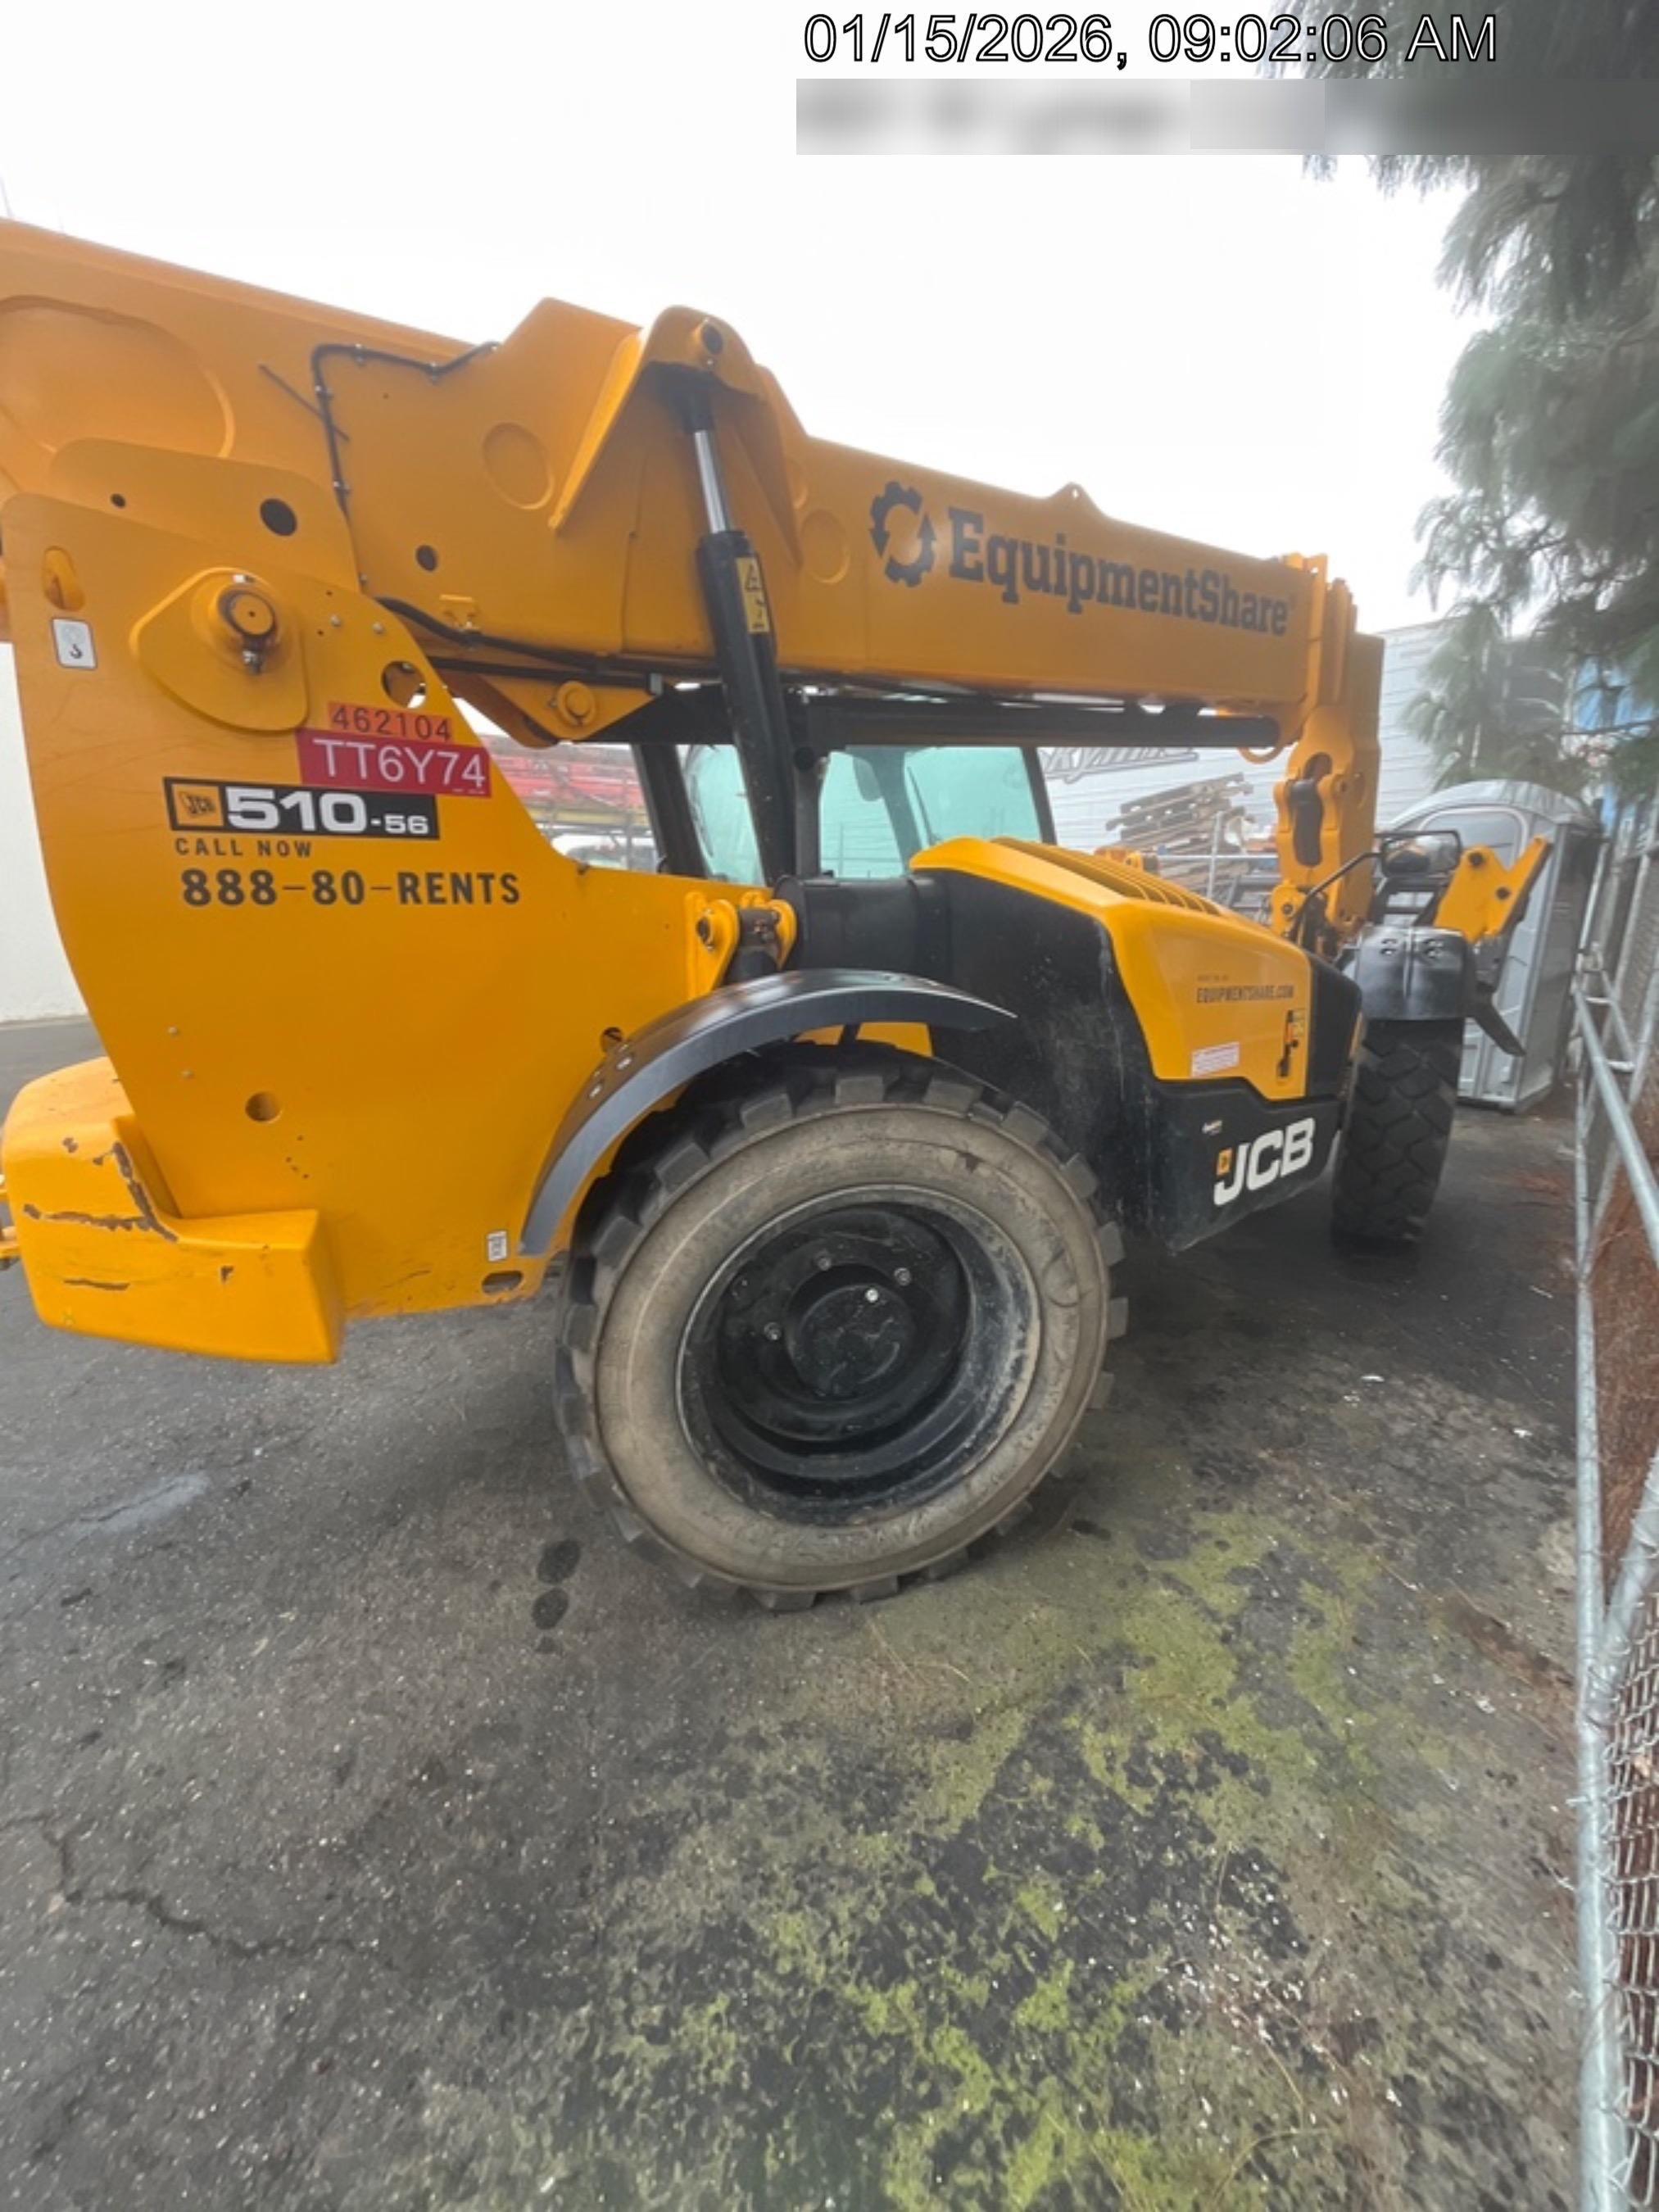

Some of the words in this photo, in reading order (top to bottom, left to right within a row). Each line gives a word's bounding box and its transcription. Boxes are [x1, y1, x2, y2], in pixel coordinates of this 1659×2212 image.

[948, 505, 1288, 636] EquipmentShare
[332, 705, 451, 741] 462104
[313, 738, 486, 787] TT6Y74
[175, 837, 243, 856] CALL
[257, 839, 313, 858] NOW
[1213, 1117, 1316, 1207] JCB
